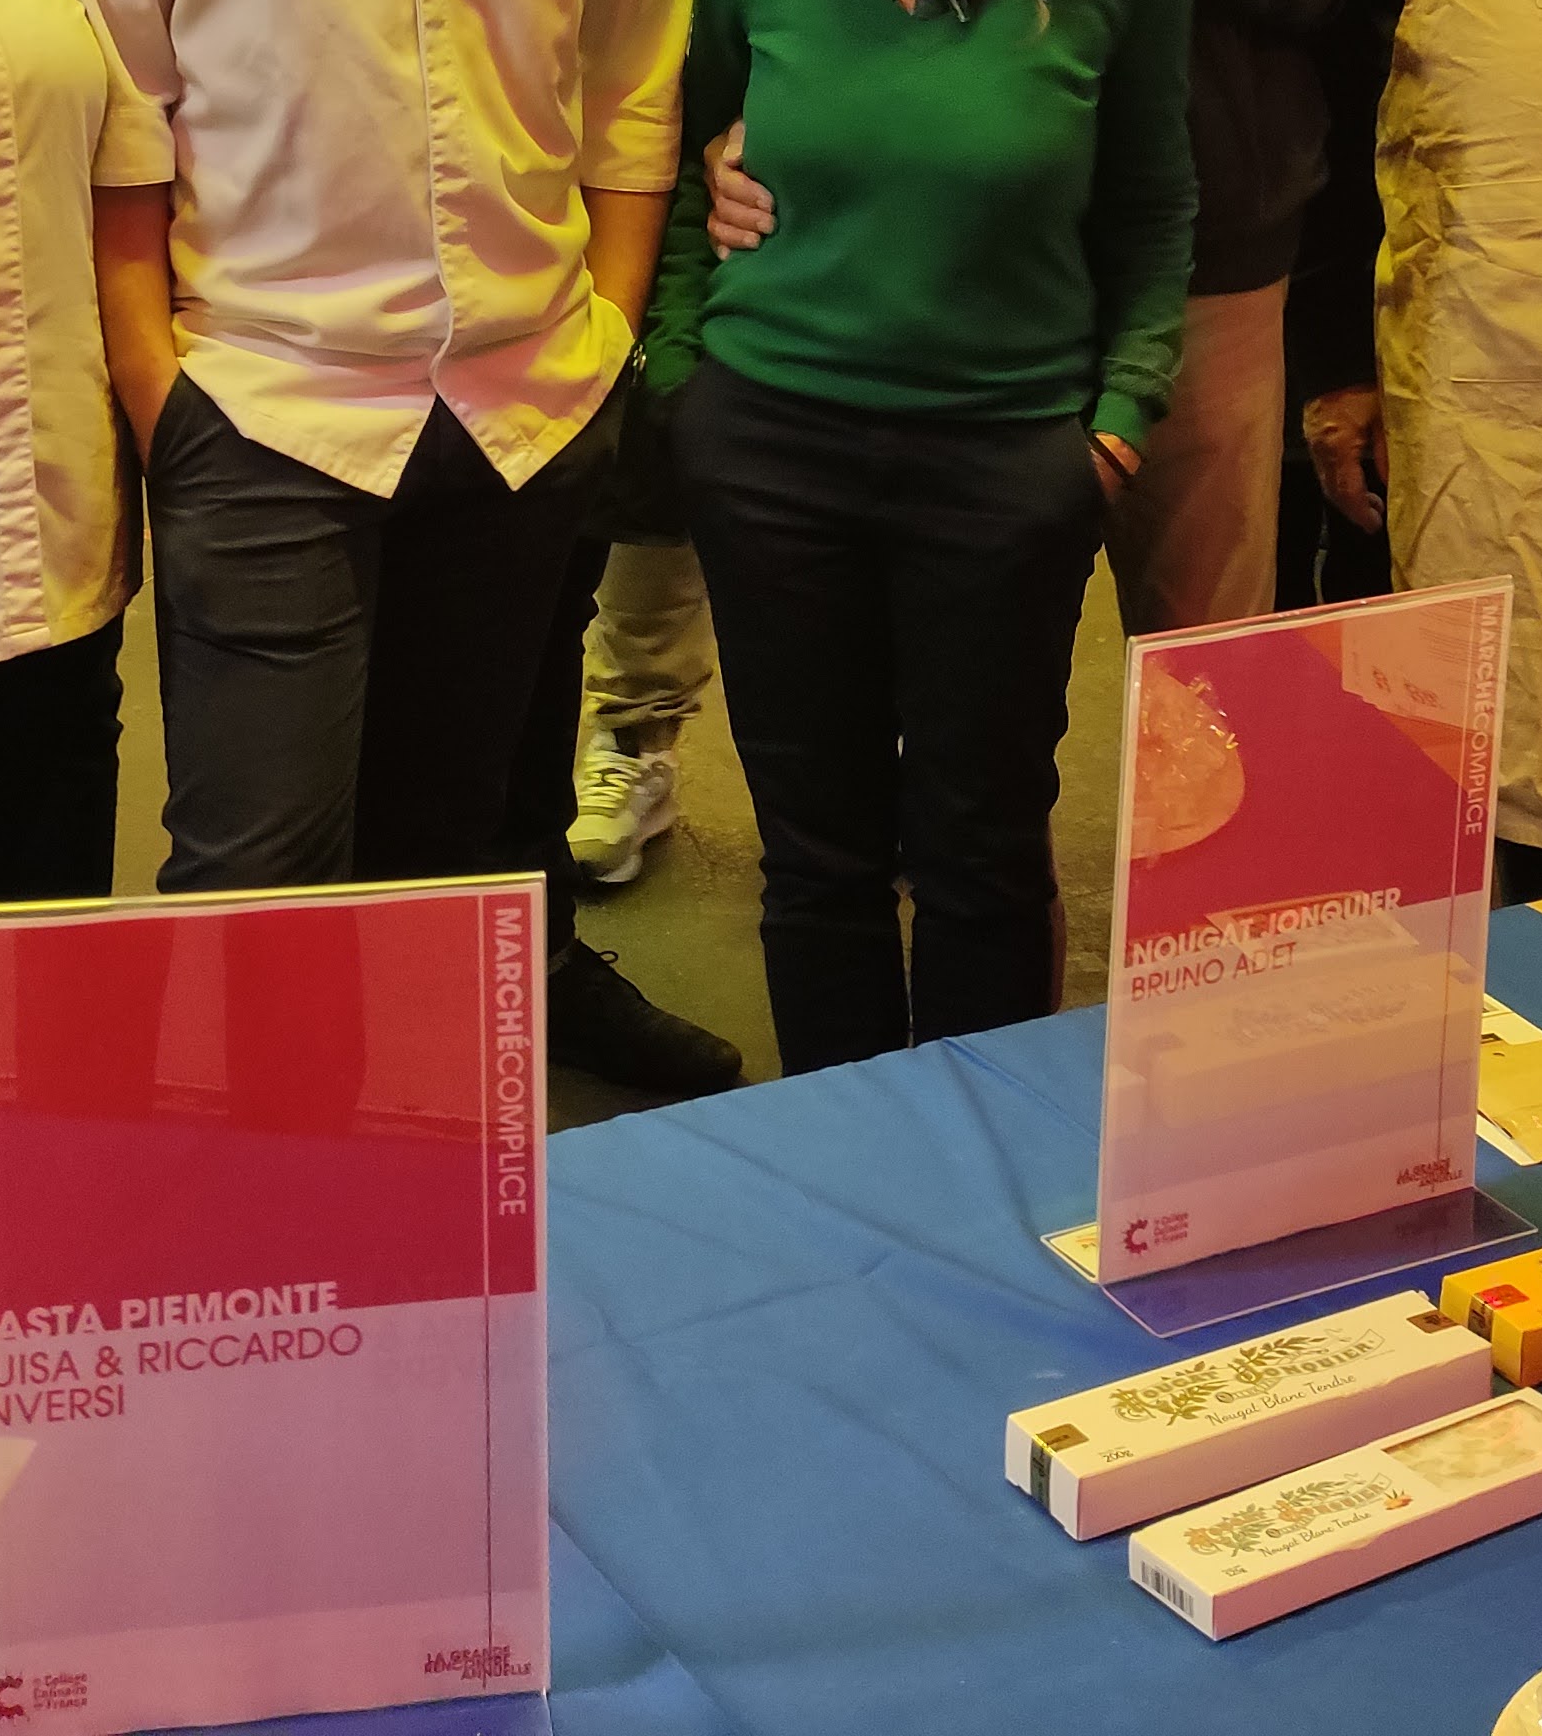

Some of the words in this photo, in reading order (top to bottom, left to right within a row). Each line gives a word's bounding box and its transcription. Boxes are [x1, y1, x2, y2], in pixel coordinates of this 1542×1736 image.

[1132, 914, 1255, 965] NOUGAT
[1256, 887, 1401, 937] JONQUIER
[1131, 956, 1225, 1002] BRUNO
[1232, 942, 1297, 979] ADET
[121, 1280, 339, 1331] PIEMONTE
[97, 1346, 124, 1378] &
[138, 1324, 363, 1375] RICCARDO
[1205, 1401, 1260, 1427] Nougat
[1262, 1389, 1306, 1410] Blanc
[1307, 1373, 1356, 1396] Tendre
[1259, 1536, 1299, 1557] Nougat
[1299, 1526, 1334, 1543] Blanc
